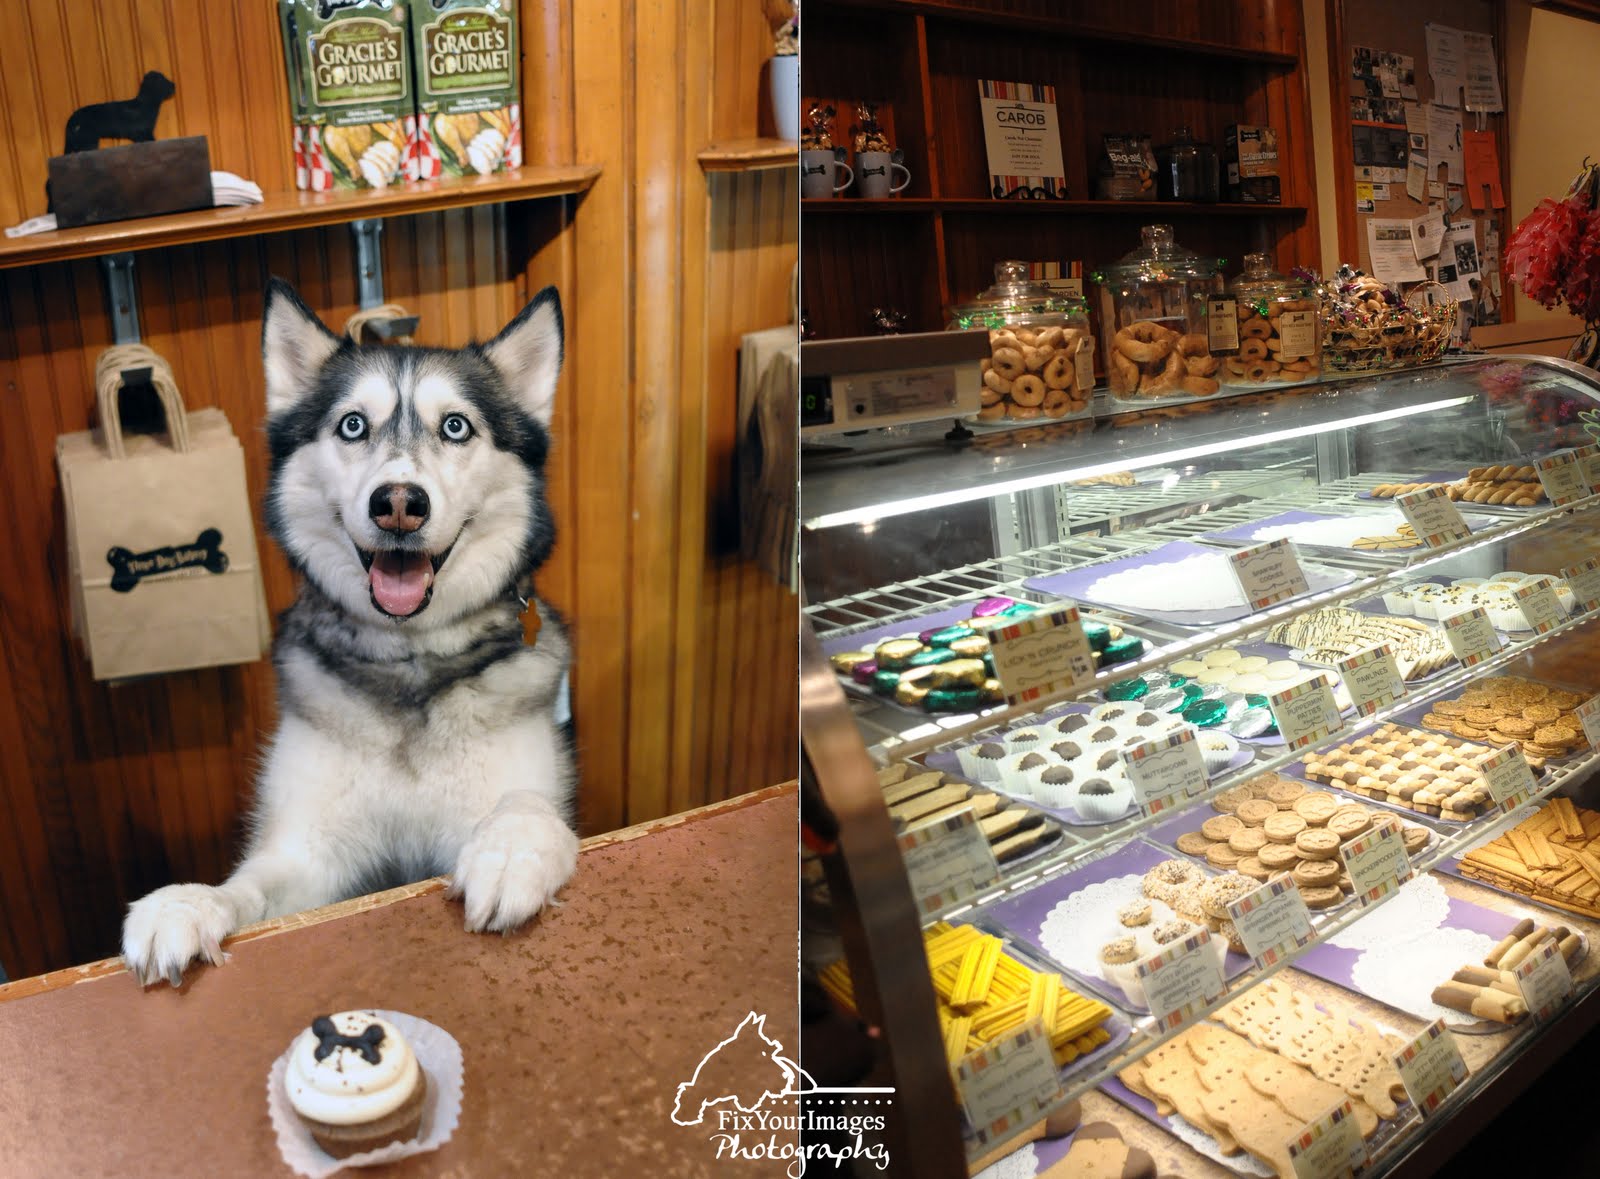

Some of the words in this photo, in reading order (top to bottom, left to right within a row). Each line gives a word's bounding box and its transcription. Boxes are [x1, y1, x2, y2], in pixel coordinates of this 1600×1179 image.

[318, 37, 398, 66] GRACIE'S
[434, 26, 505, 54] GRACIE'S
[316, 61, 402, 87] GOURMET
[430, 50, 508, 75] GOURMET
[996, 111, 1046, 125] CAROB
[1356, 666, 1389, 684] PAWLINES
[1286, 694, 1325, 716] PUPPERMINT
[1297, 705, 1322, 720] PATTIES
